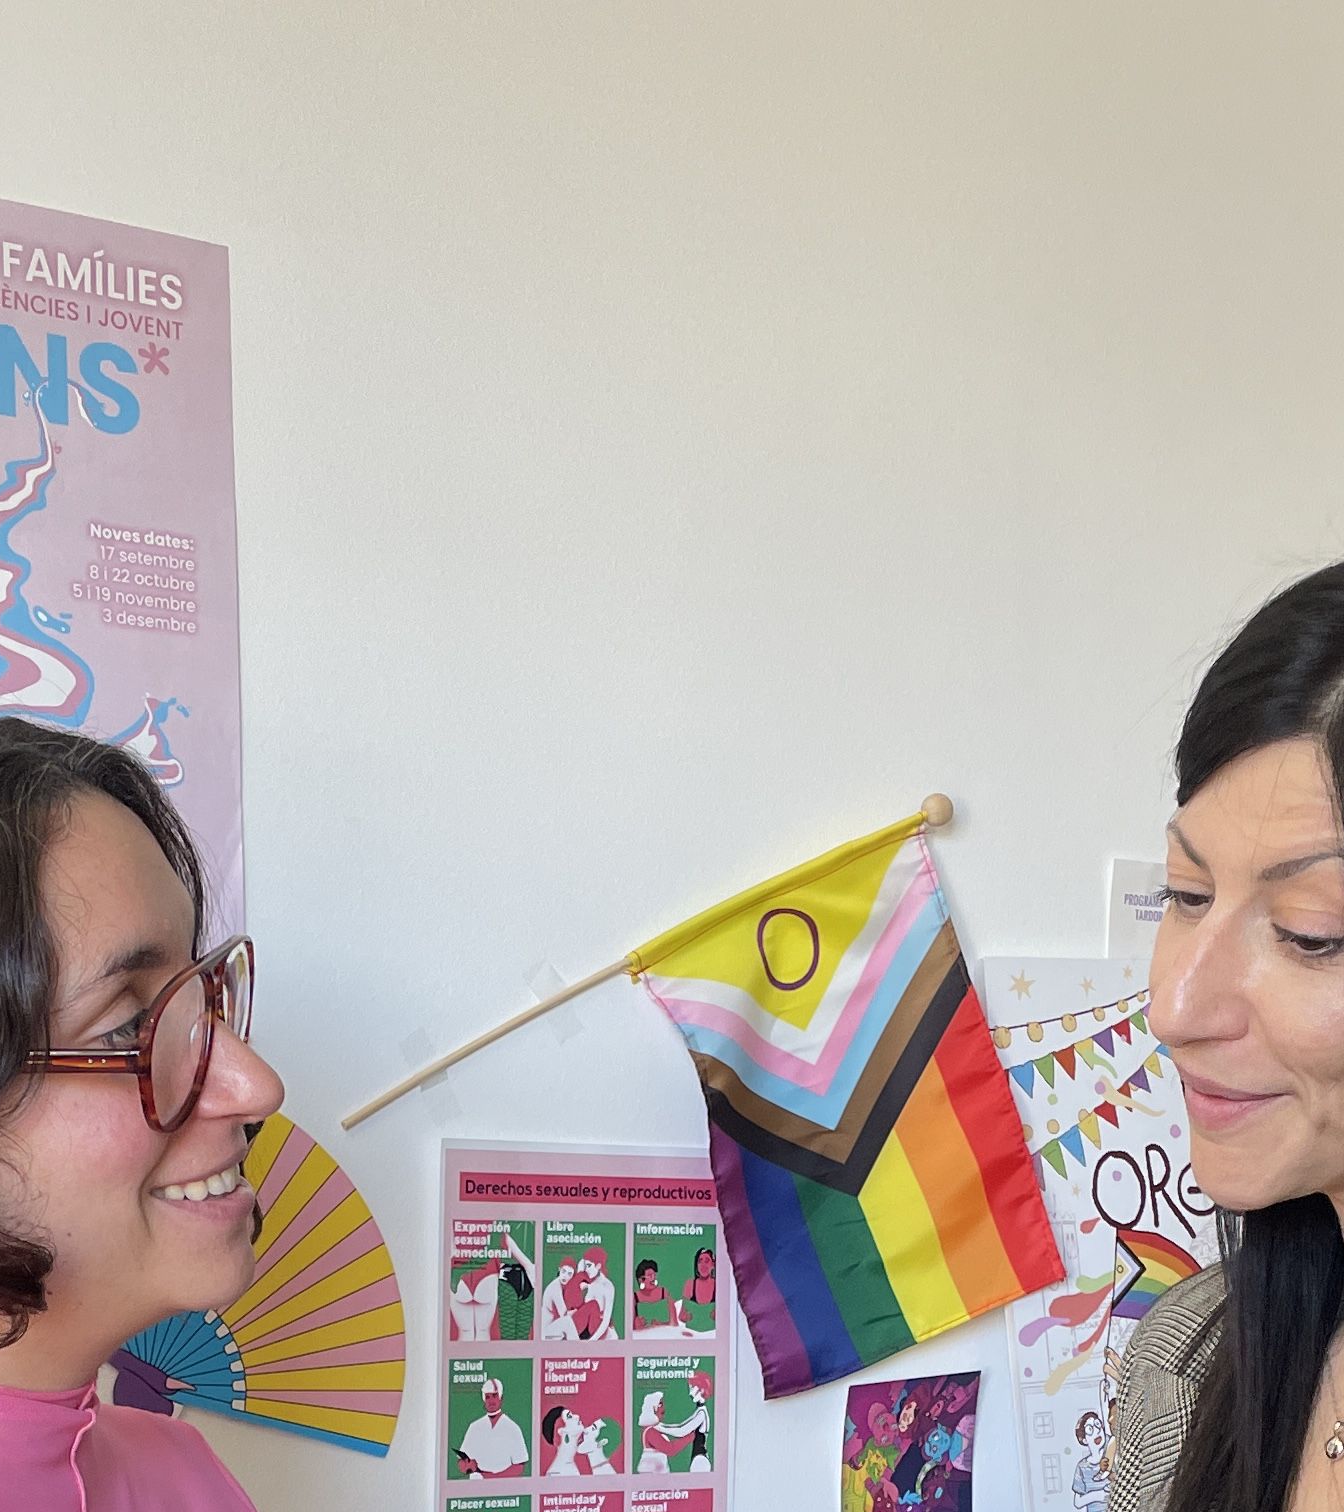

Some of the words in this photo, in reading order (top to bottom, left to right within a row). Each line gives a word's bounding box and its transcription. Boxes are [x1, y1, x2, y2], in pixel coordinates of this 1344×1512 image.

[2, 243, 184, 311] FAMÍLIES
[85, 304, 92, 324] I
[98, 309, 184, 341] JOVENT
[90, 523, 141, 543] Noves
[144, 532, 195, 551] dates:
[99, 545, 115, 561] 17
[119, 549, 195, 572] setembre
[89, 565, 99, 580] 8
[112, 568, 131, 584] 22
[134, 571, 196, 592] octubre
[72, 583, 83, 598] 5
[95, 586, 111, 601] 19
[115, 591, 197, 613] novembre
[102, 608, 112, 623] 3
[116, 611, 197, 634] desembre
[465, 1179, 533, 1197] Derechos
[536, 1182, 599, 1198] sexuales
[602, 1187, 610, 1202] y
[613, 1185, 712, 1202] reproductivos
[1092, 1143, 1216, 1239] ORG
[454, 1221, 511, 1235] Expresión
[546, 1221, 574, 1232] Libre
[636, 1224, 703, 1236] Información
[454, 1234, 491, 1246] sexual
[546, 1232, 602, 1244] asociación
[453, 1247, 512, 1259] emocional
[453, 1360, 484, 1371] Salud
[544, 1359, 590, 1373] Igualdad
[591, 1361, 599, 1373] y
[636, 1356, 690, 1370] Seguridad
[691, 1358, 700, 1370] y
[453, 1372, 488, 1383] sexual
[544, 1371, 586, 1382] libertad
[636, 1368, 695, 1380] autonomía
[544, 1383, 579, 1394] sexual
[543, 1494, 596, 1507] Intimidad
[597, 1494, 606, 1507] y
[631, 1489, 689, 1501] Educación
[450, 1499, 484, 1511] Placer
[485, 1497, 520, 1508] sexual
